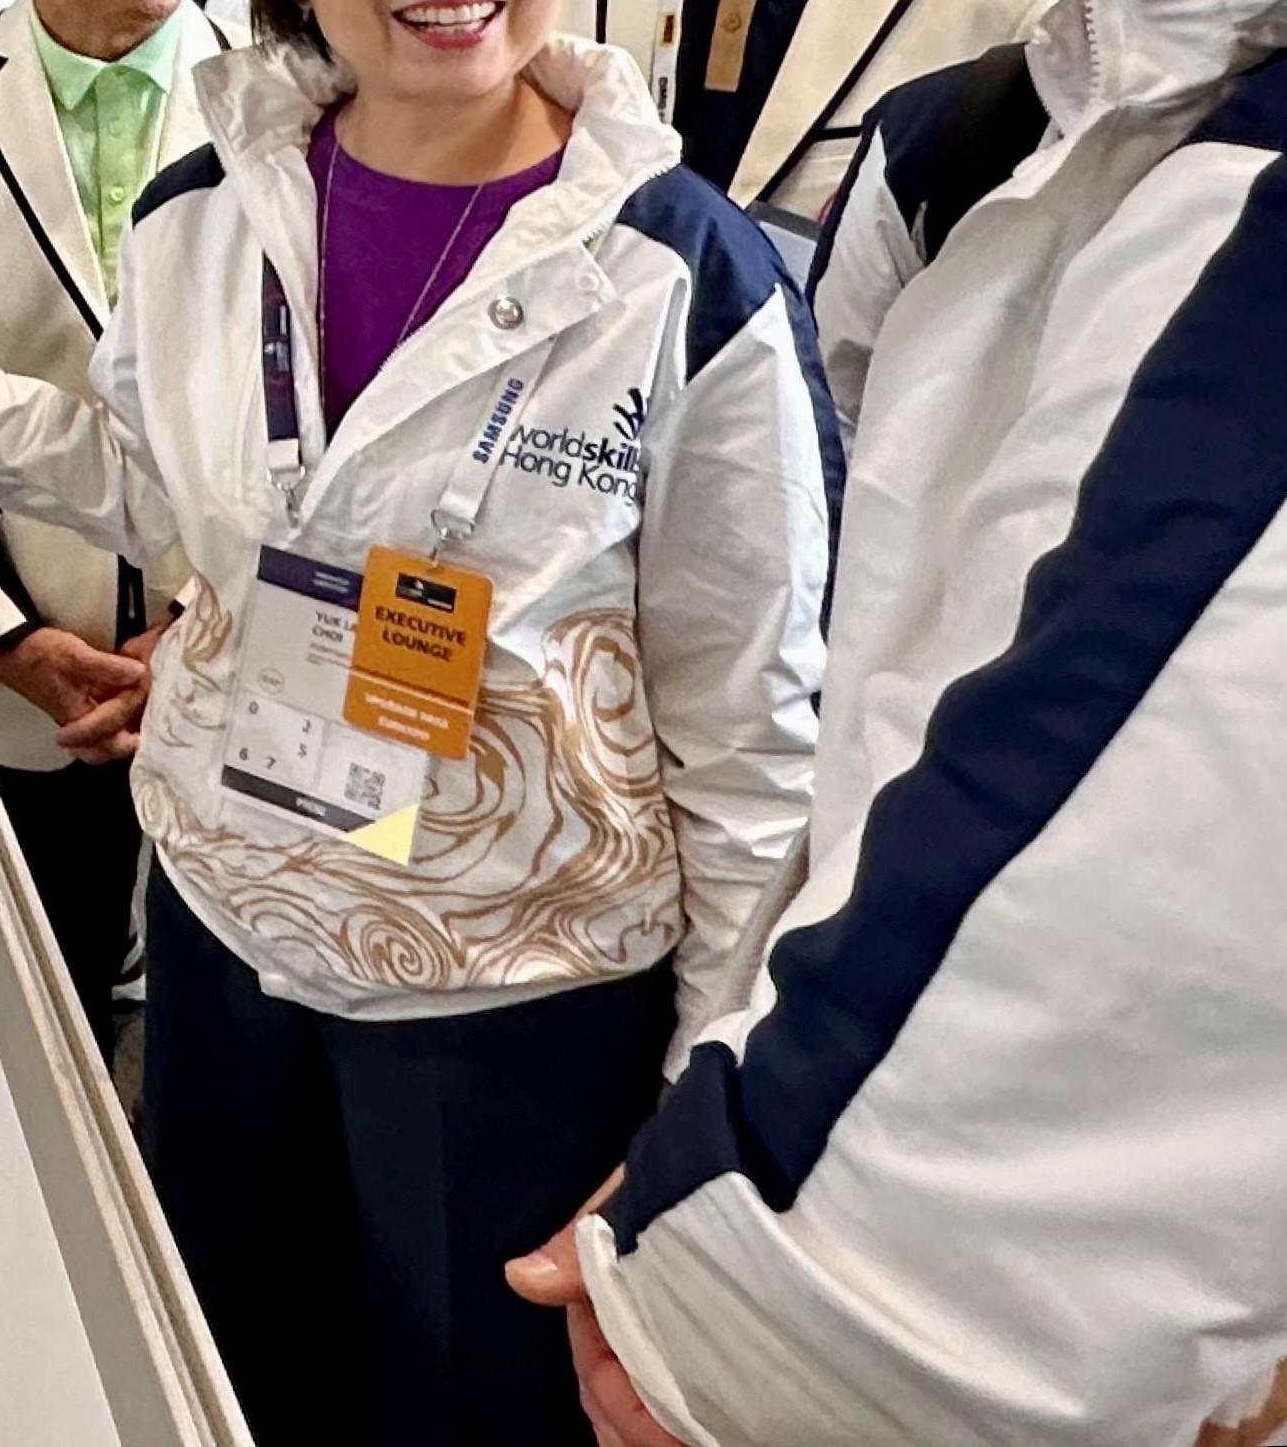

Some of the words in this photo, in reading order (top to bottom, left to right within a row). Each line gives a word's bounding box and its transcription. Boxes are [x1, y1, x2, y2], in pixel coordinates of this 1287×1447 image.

[472, 377, 524, 464] SAMSUNG
[499, 444, 572, 487] Hong
[375, 605, 467, 647] EXECUTIVE
[382, 627, 452, 662] LOUNGE
